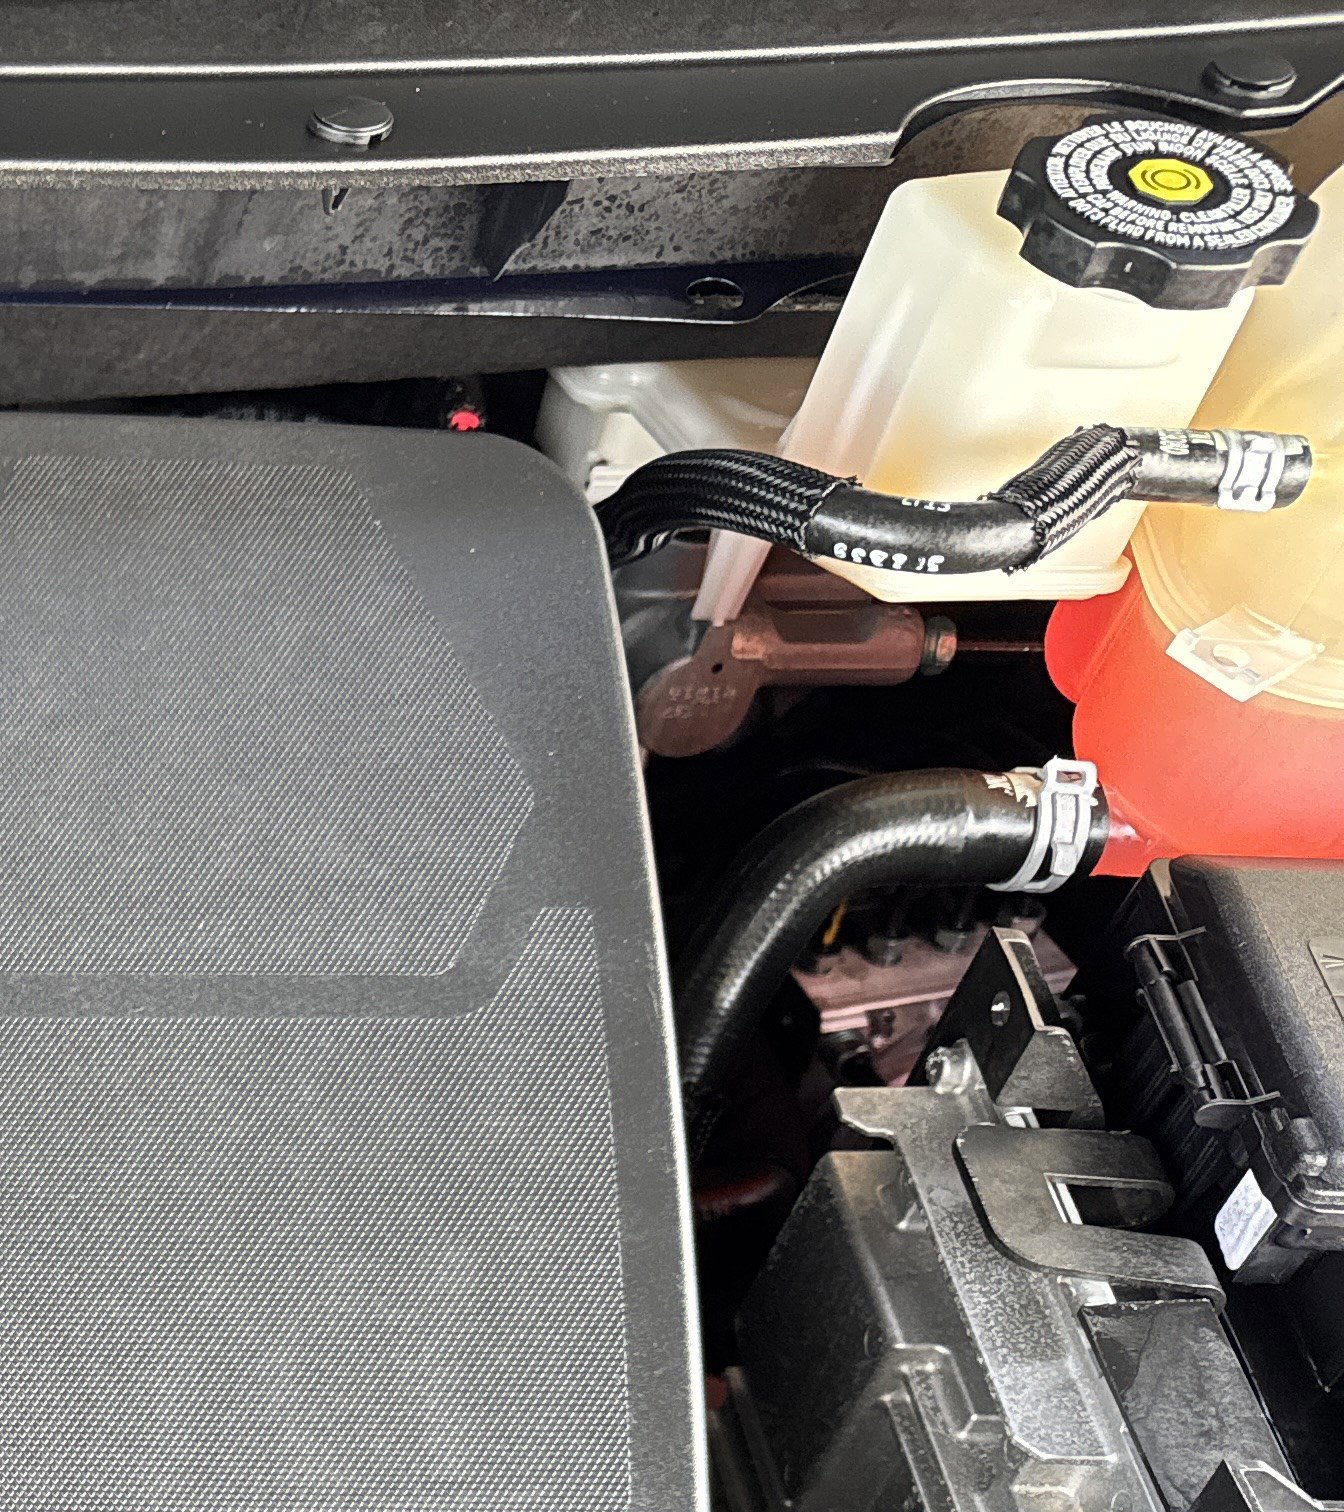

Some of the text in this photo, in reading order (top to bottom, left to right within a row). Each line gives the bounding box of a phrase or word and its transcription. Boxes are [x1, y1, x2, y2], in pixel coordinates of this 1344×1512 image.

[1085, 193, 1114, 209] CAP
[1108, 206, 1167, 231] BEFORE
[1098, 215, 1146, 239] FLUID
[1144, 228, 1191, 249] FROM
[1192, 235, 1206, 250] A
